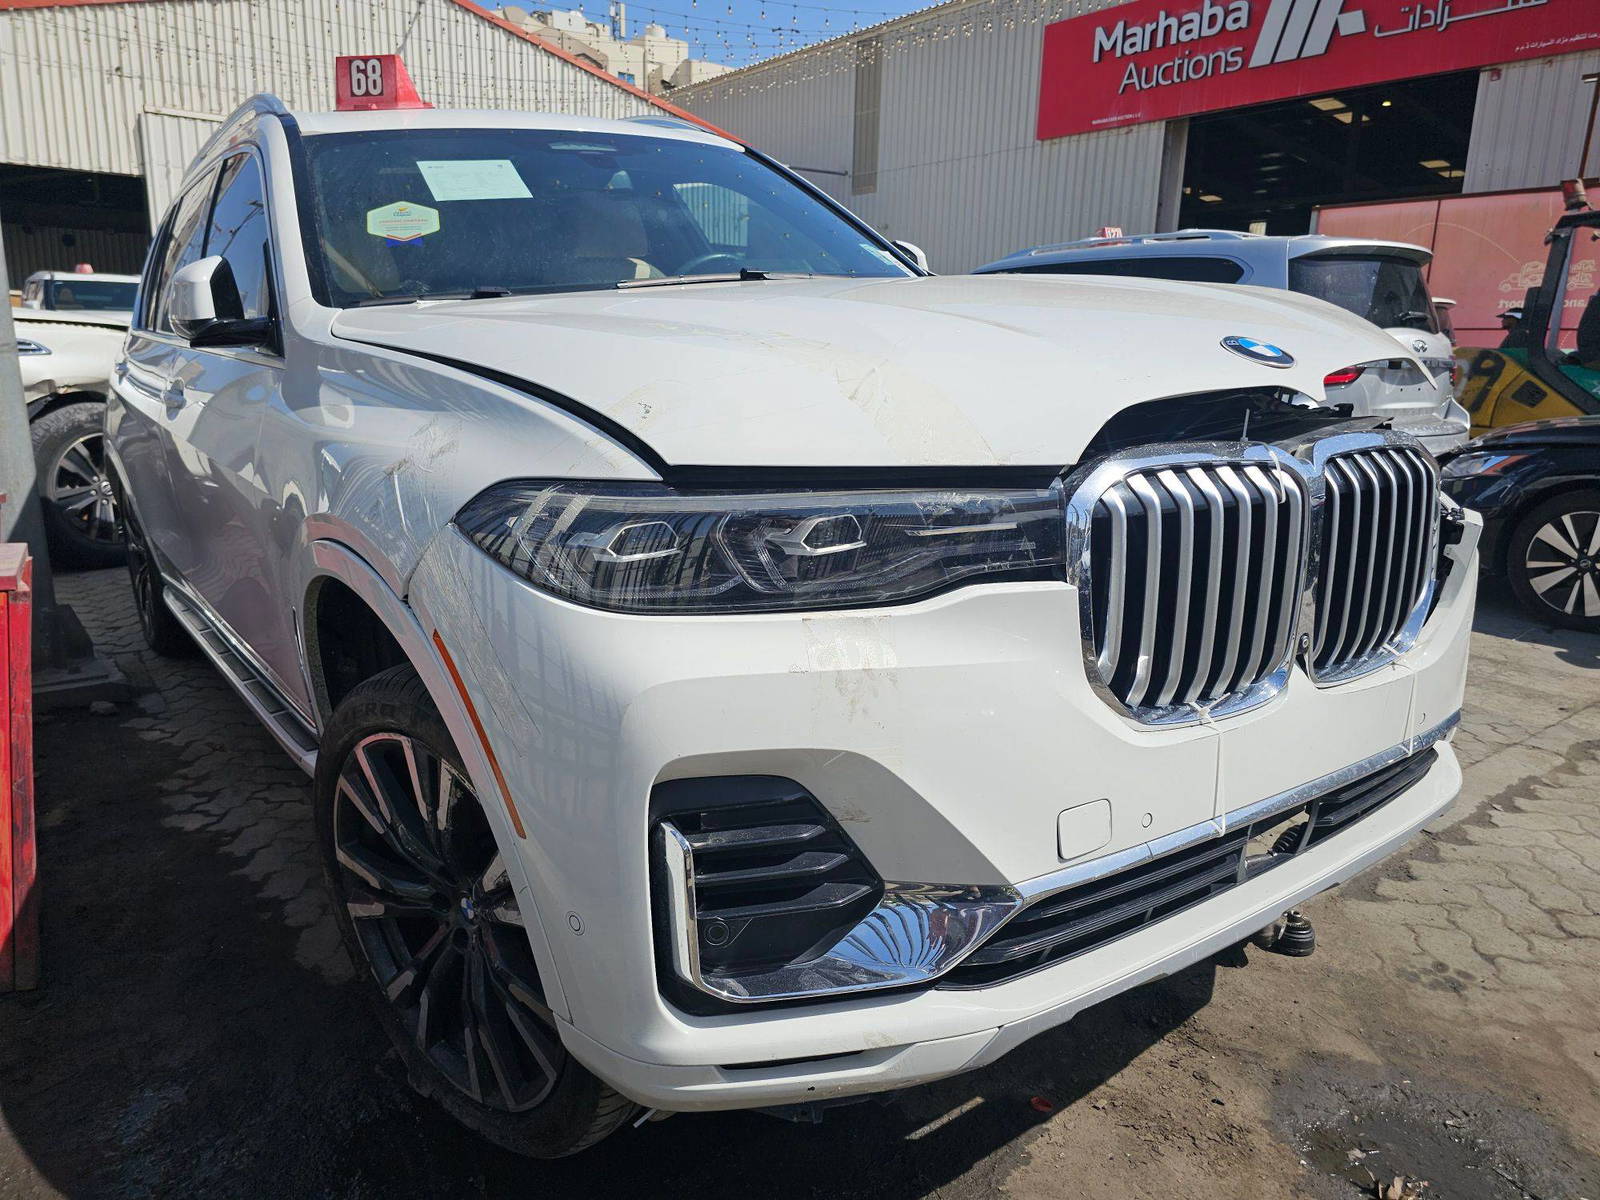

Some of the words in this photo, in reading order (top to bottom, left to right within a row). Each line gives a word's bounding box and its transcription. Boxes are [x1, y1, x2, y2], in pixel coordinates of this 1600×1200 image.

[1093, 0, 1250, 63] Marhaba
[351, 58, 382, 96] 68
[1118, 46, 1244, 95] Auctions
